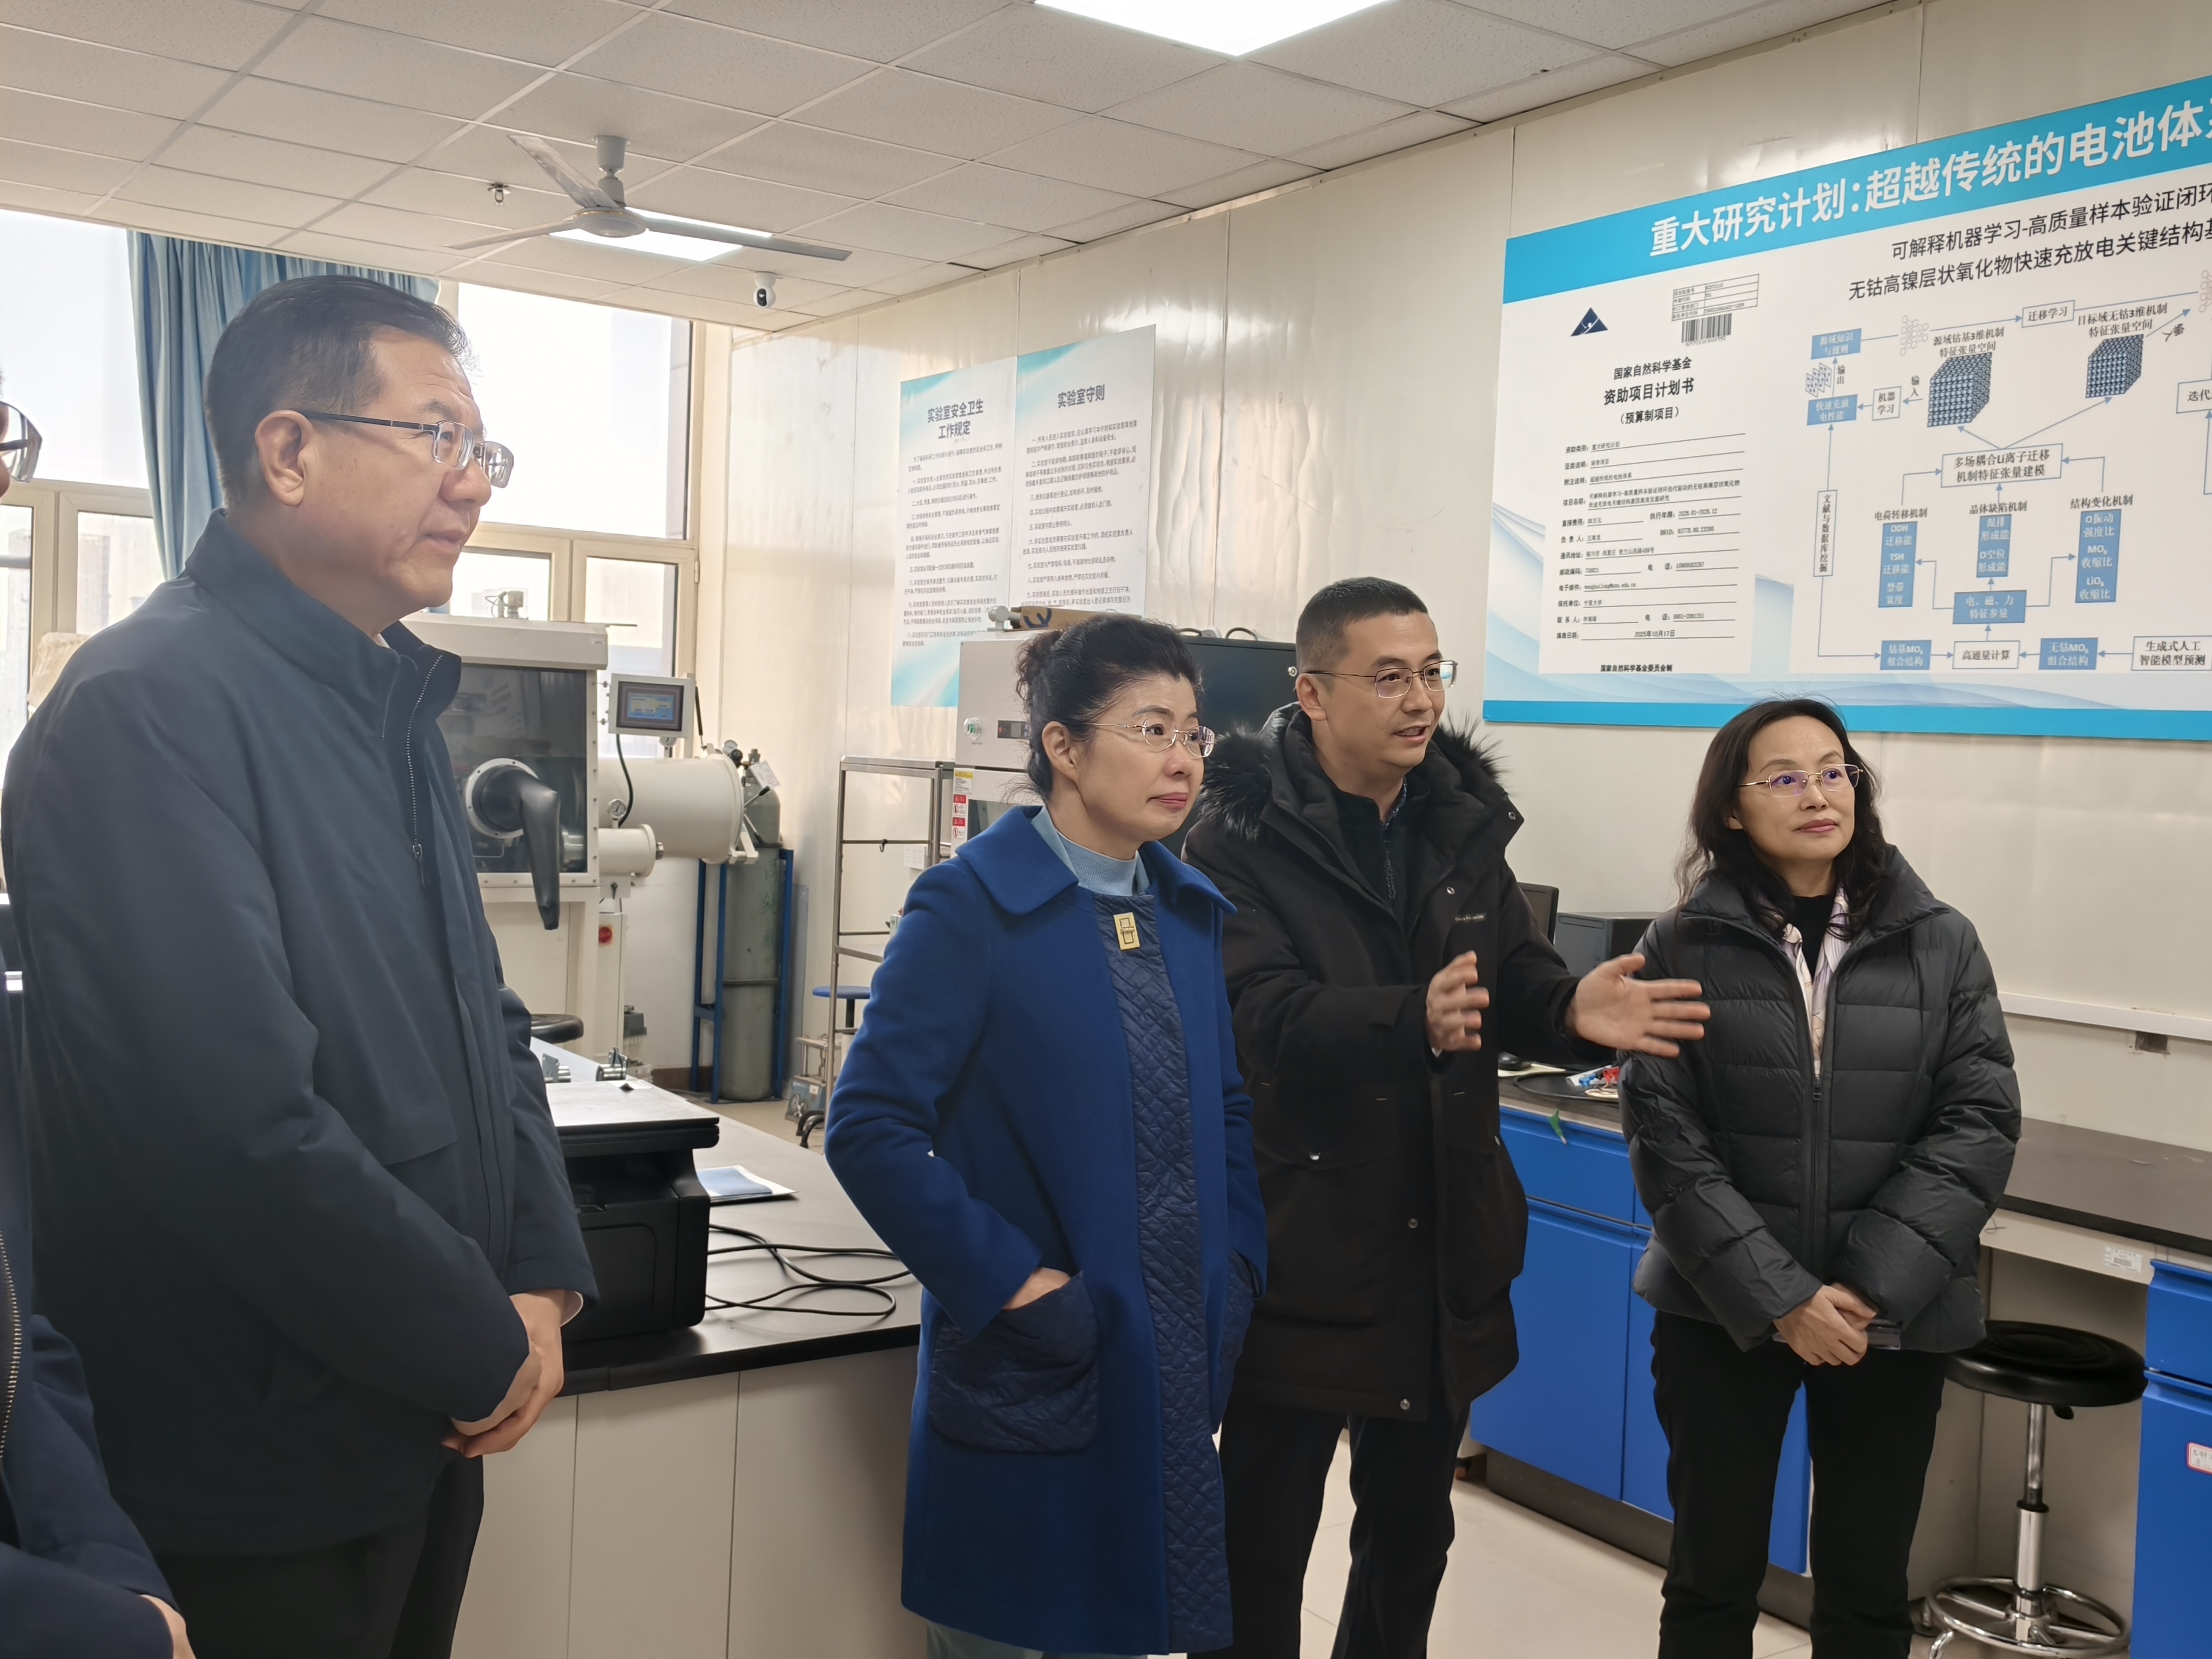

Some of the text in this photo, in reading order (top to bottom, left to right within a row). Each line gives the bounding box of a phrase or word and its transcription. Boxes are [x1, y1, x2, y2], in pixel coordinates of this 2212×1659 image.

[1649, 98, 2212, 258] 重大研究计划：超越传统的电池体
[2027, 306, 2068, 322] 迁移学习
[2078, 302, 2168, 326] 目标域无钴3维机制
[2088, 319, 2153, 338] 特征张量空间
[1933, 327, 2005, 346] 源域钴基3维机制
[1939, 341, 1996, 358] 特征张量空间
[1614, 356, 1692, 380] 国家自然科学基金
[1837, 365, 1846, 385] 输出
[1604, 377, 1695, 406] 资助项目计划书
[1911, 375, 1920, 397] 输入
[1057, 383, 1105, 409] 实验室守则
[1878, 392, 1896, 403] 机器
[2187, 389, 2212, 401] 迭代
[927, 398, 983, 423] 实验室安全卫生
[1877, 404, 1894, 415] 学习
[938, 420, 970, 439] 工作规定
[1954, 449, 2049, 469] 多场耦合Li离子迁移
[1957, 464, 2045, 483] 机制特征张量建模
[1970, 501, 2027, 515] 晶体缺陷机制
[2071, 494, 2133, 510] 结构变化机制
[1874, 507, 1927, 521] 电荷转移机制
[1819, 494, 1831, 572] 文献与数据库挖掘
[1890, 524, 1908, 532] ODH
[1981, 530, 2009, 541] 形成能
[2083, 525, 2115, 537] 强度比
[1885, 536, 1912, 546] 迁移能
[1883, 564, 1910, 575] 迁移能
[1978, 562, 2006, 572] 形成能
[2081, 557, 2112, 568] 收缩比
[2080, 589, 2110, 600] 收缩比
[2146, 640, 2201, 652] 生成式人工
[1962, 650, 2010, 661] 高通量计算
[2140, 654, 2206, 666] 智能模型预测
[1600, 664, 1673, 672] 国家自然科学基金委员会制
